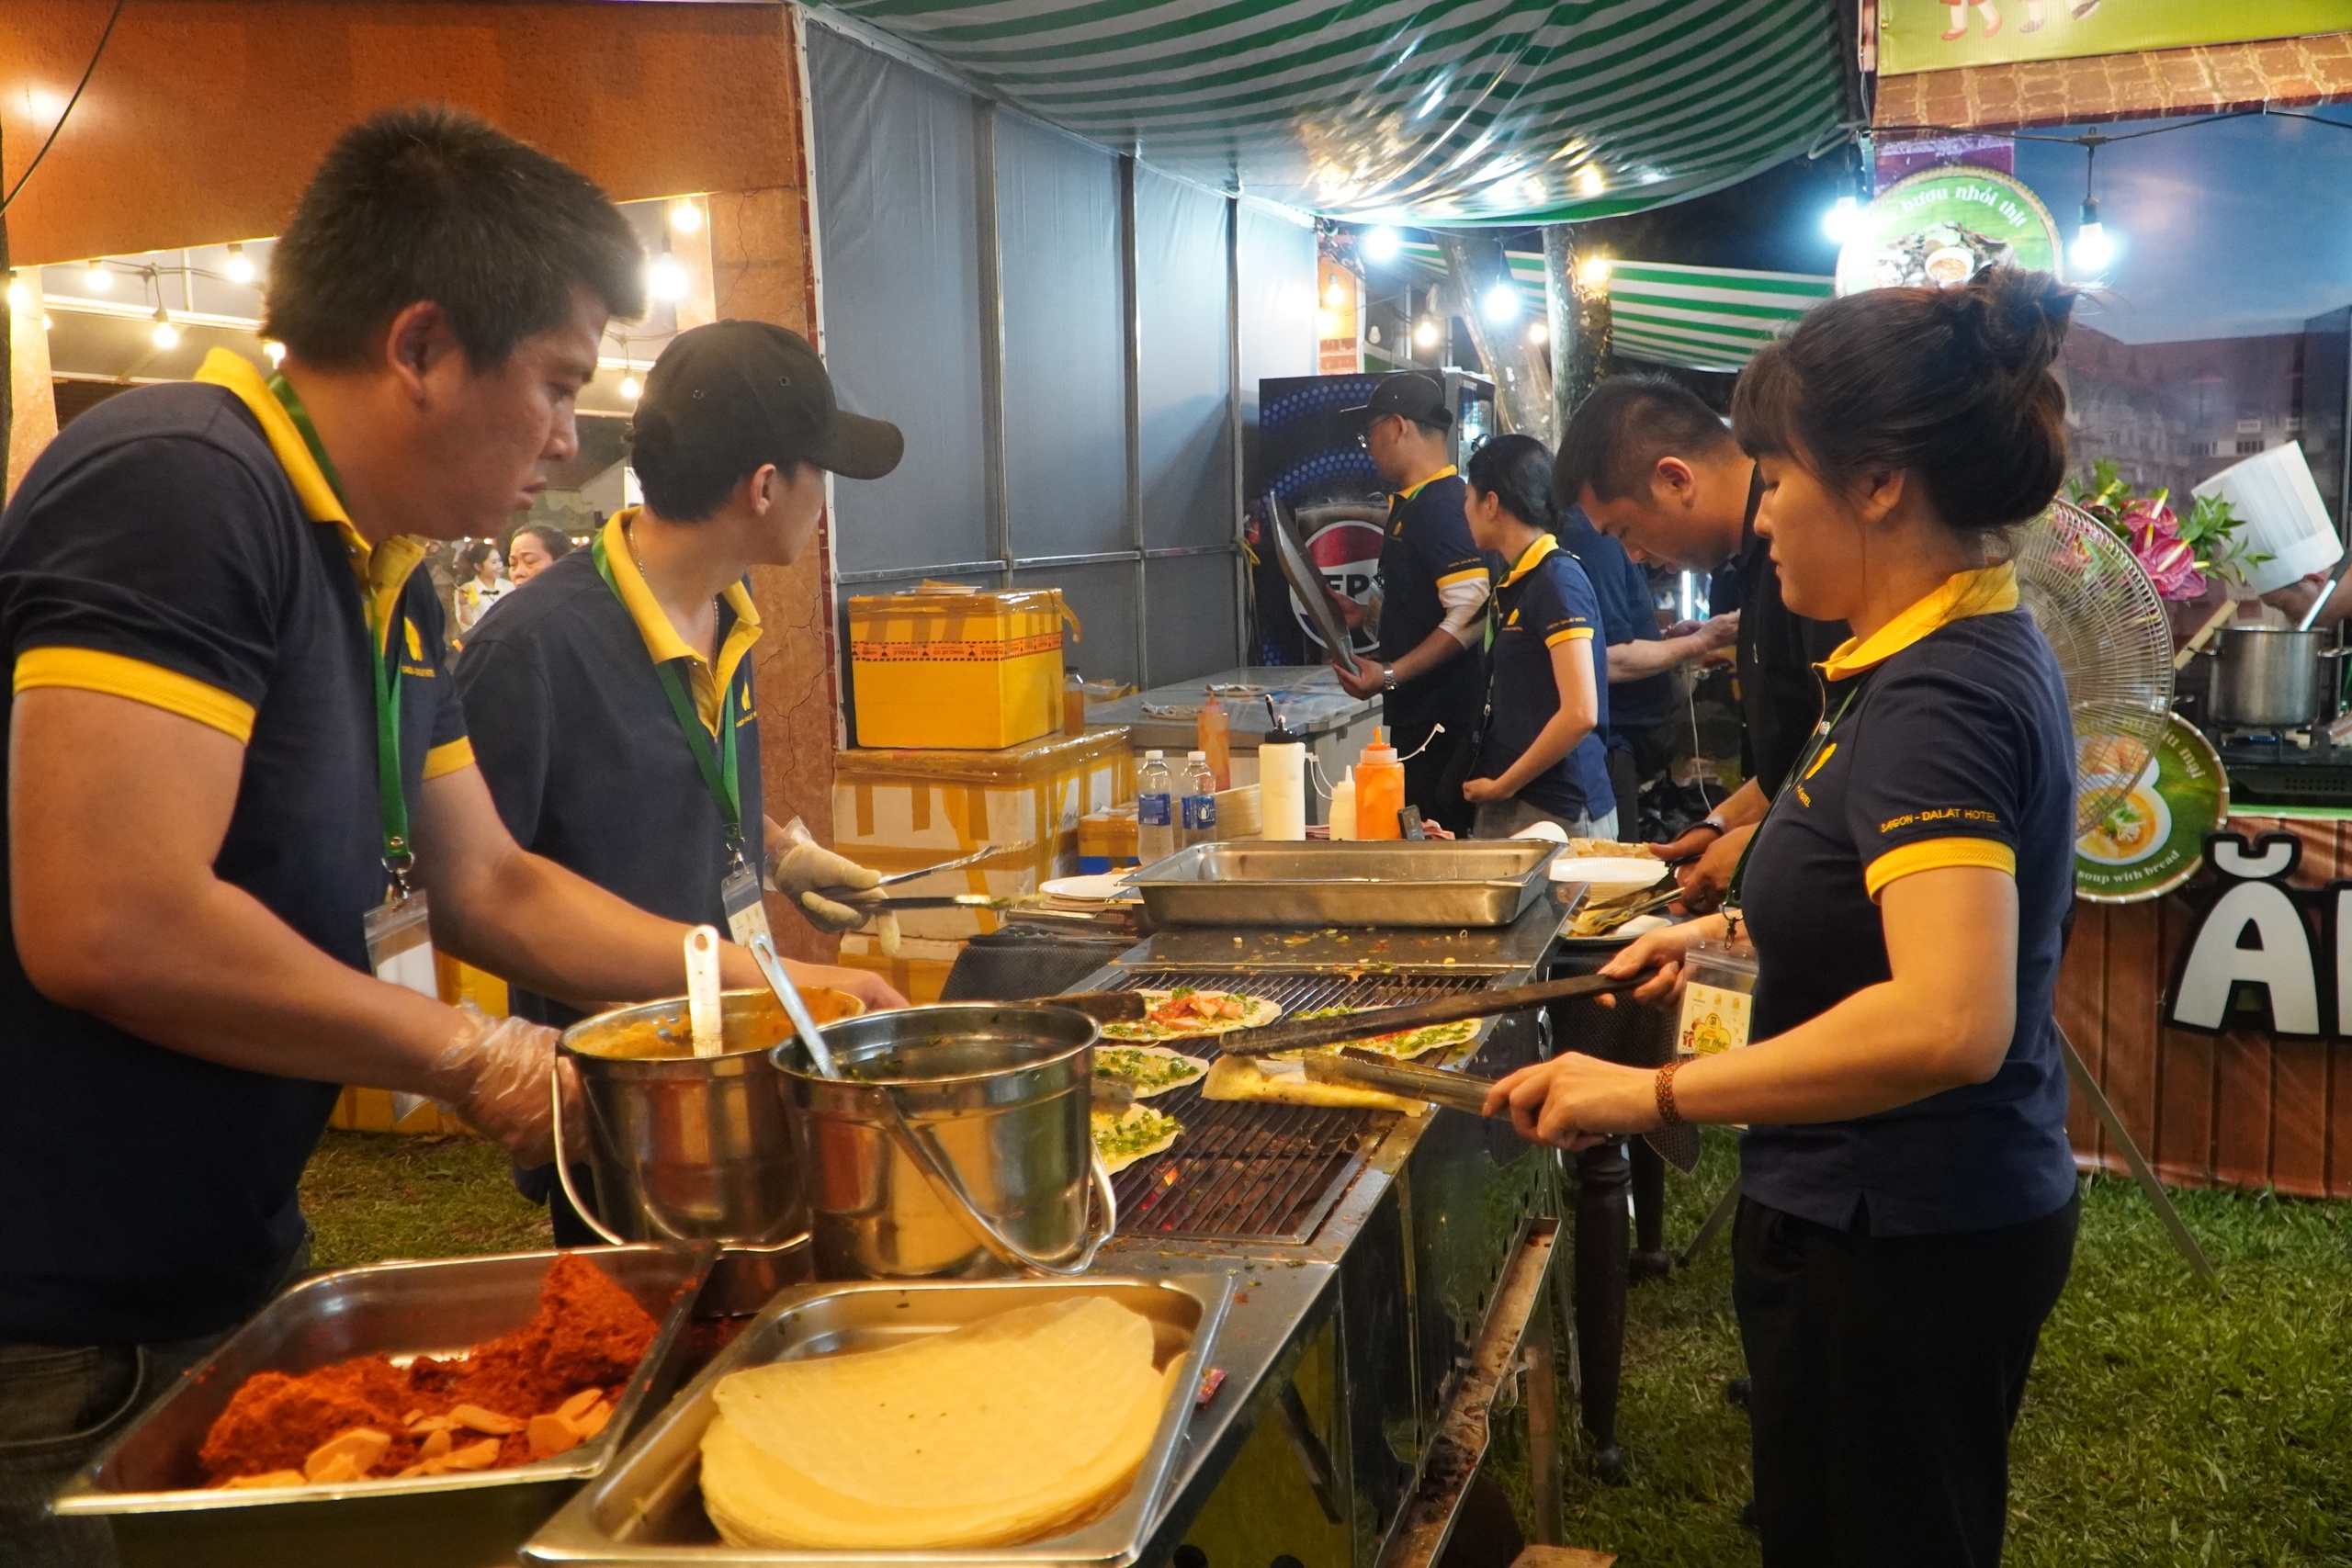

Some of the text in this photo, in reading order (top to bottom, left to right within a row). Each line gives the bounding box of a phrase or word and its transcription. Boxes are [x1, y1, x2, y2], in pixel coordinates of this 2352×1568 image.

[1881, 814, 1914, 833] SAIGON
[1922, 808, 1961, 821] DALAT
[1964, 809, 2000, 823] HOTEL
[2077, 850, 2180, 885] soup with bread
[2172, 840, 2352, 1036] Ă
